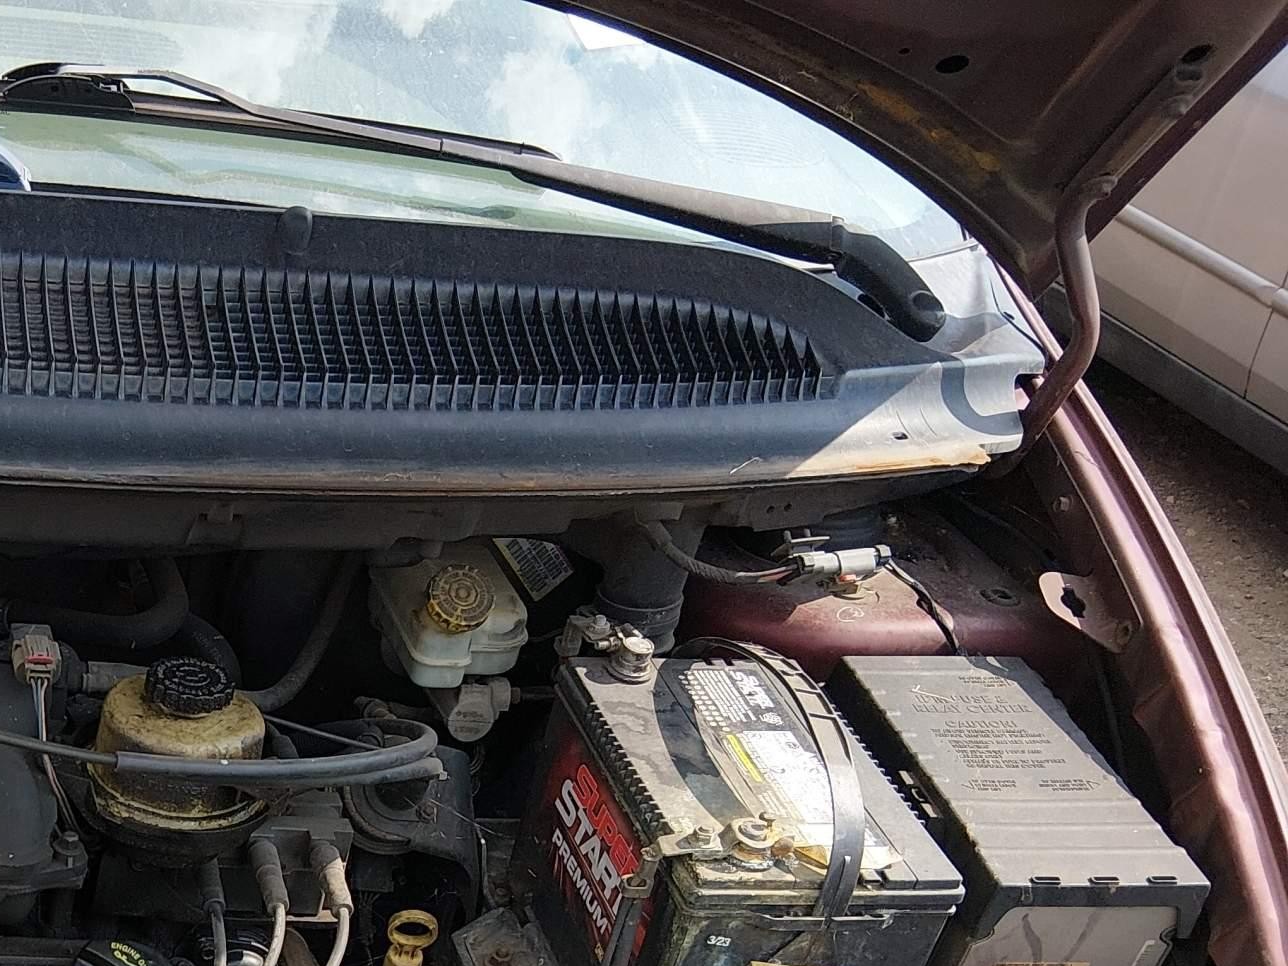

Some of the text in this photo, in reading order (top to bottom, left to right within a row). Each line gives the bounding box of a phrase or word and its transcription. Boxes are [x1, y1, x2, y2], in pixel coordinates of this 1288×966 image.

[911, 703, 1033, 714] RELAY CENTER
[552, 827, 608, 934] PREMIUM
[706, 935, 732, 947] 3/23
[110, 941, 141, 960] ENGINE
